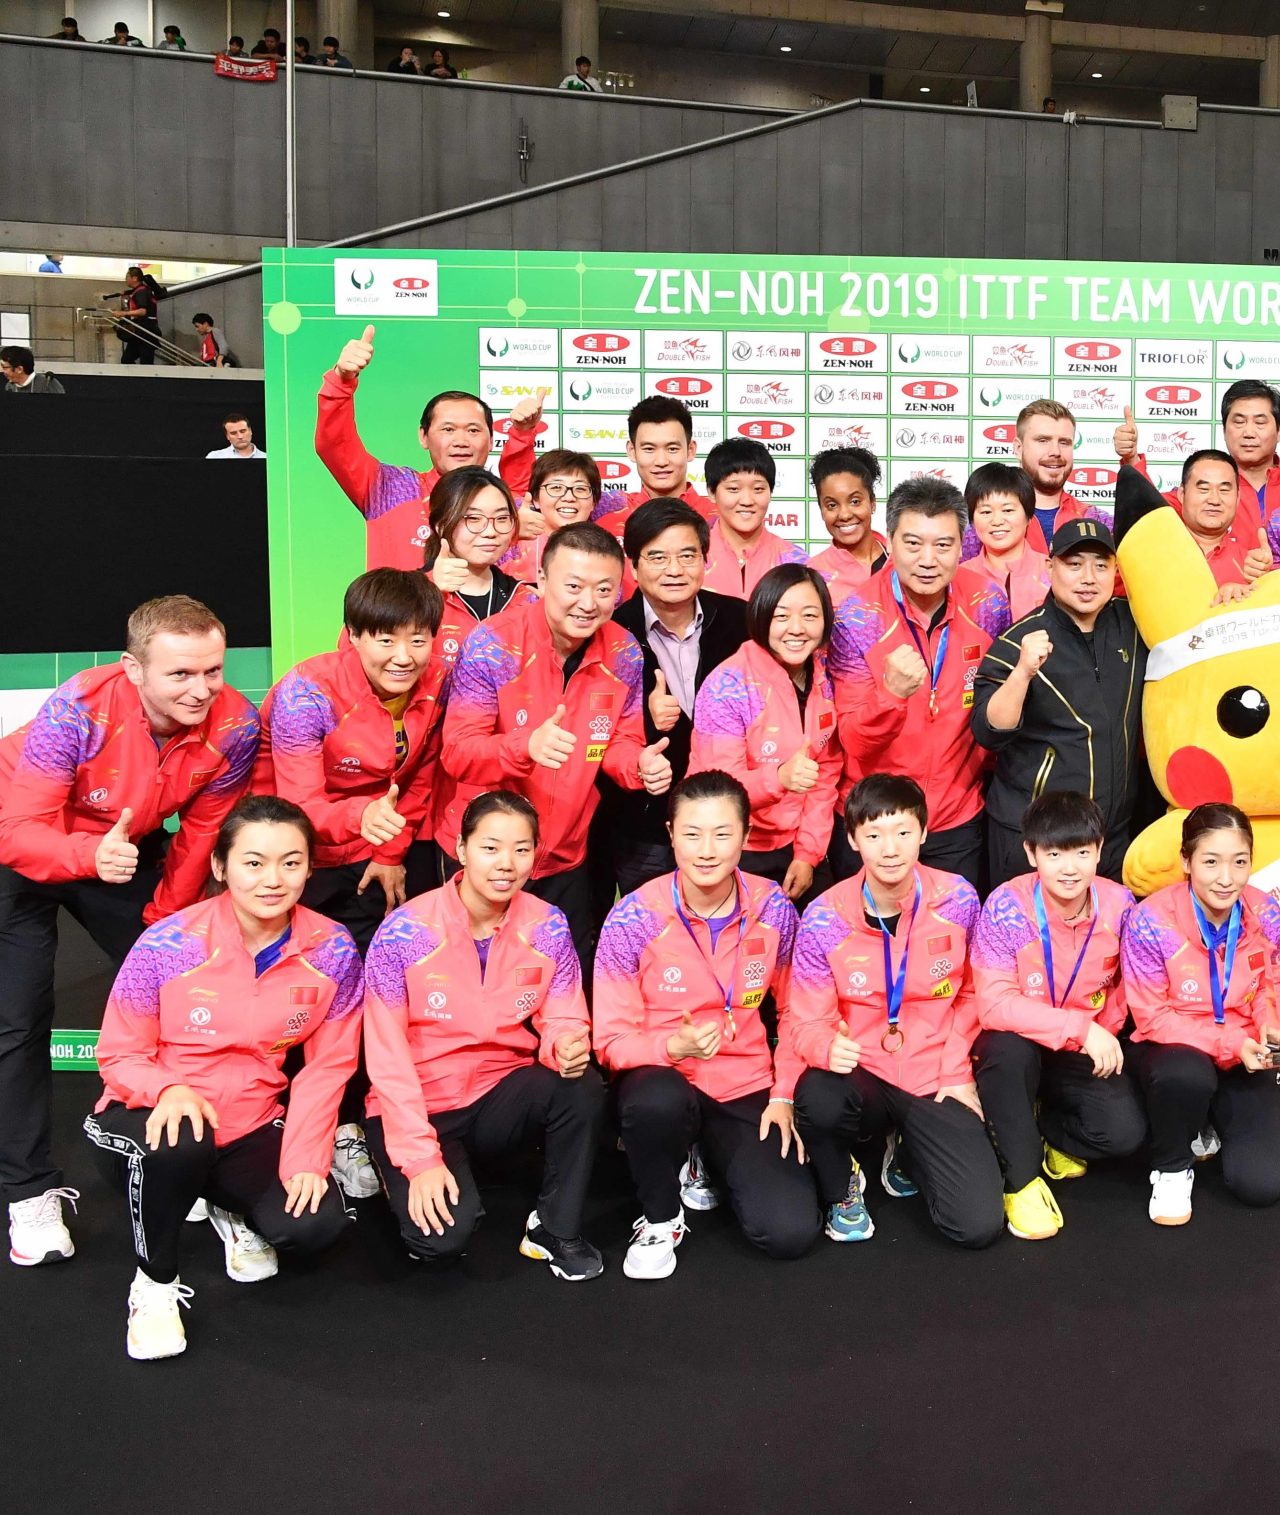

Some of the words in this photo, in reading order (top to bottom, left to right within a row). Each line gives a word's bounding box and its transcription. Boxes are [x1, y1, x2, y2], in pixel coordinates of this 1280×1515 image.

[634, 269, 824, 317] ZEN-NOH
[840, 272, 939, 318] 2019
[959, 274, 1048, 321] ITTF
[1064, 277, 1172, 324] TEAM
[576, 356, 626, 365] ZEN-NOH
[1140, 353, 1205, 364] TRIOFLOR
[823, 359, 873, 368] ZEN-NOH
[1068, 364, 1118, 373] ZEN-NOH
[905, 403, 955, 412] ZEN-NOH
[1148, 407, 1198, 416] ZEN-NOH
[582, 429, 629, 440] SAN-E
[1077, 523, 1097, 537] 11
